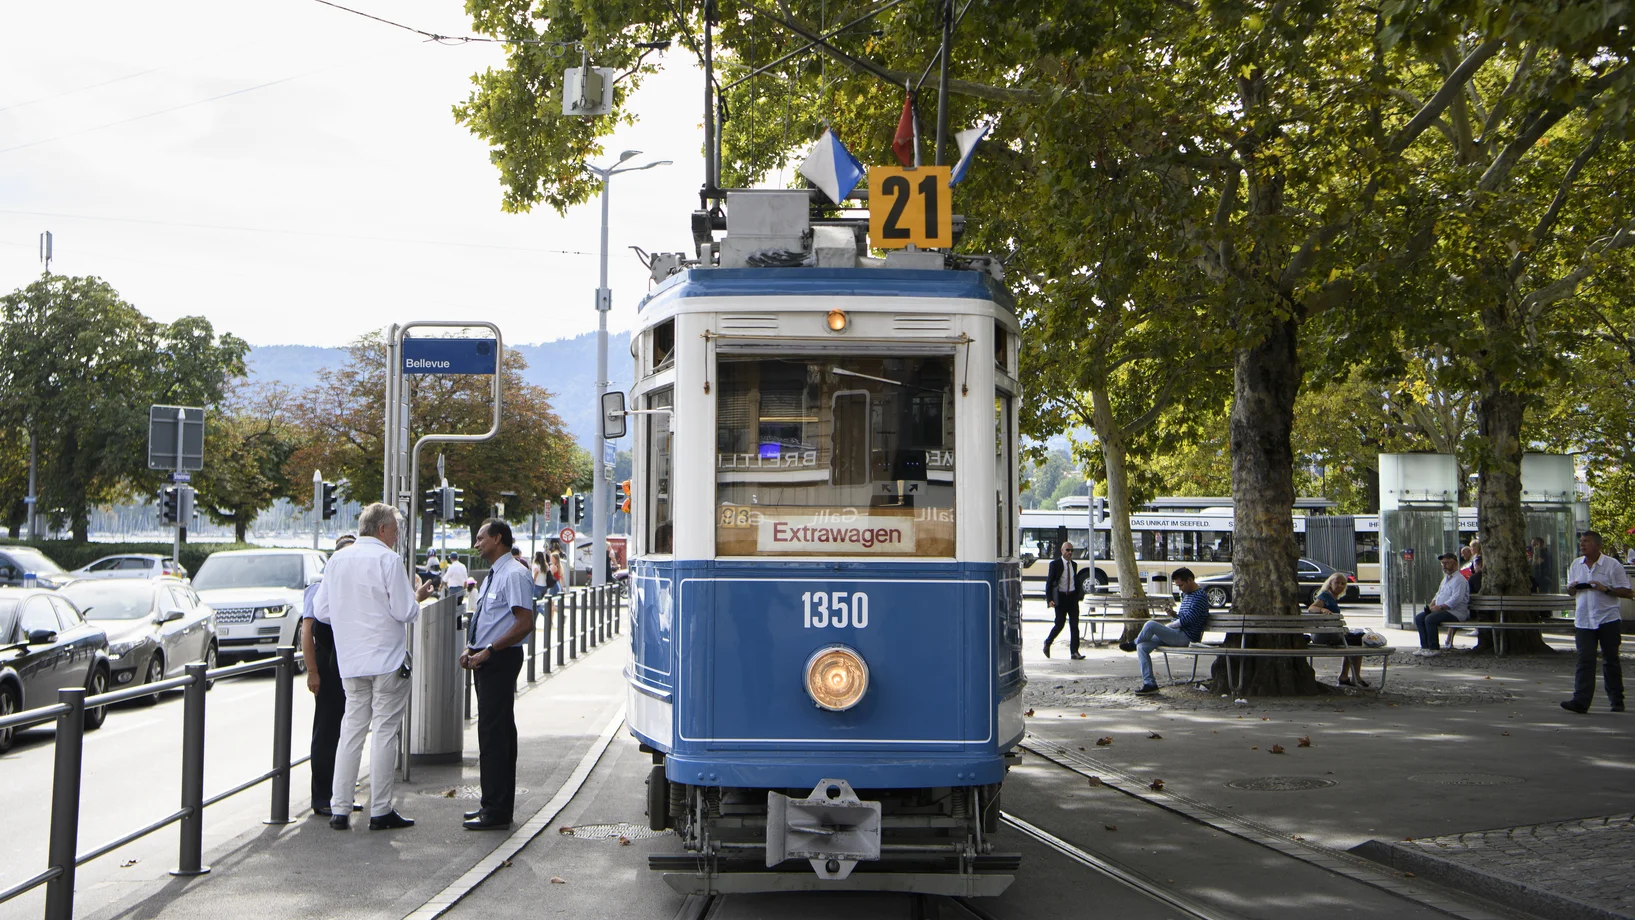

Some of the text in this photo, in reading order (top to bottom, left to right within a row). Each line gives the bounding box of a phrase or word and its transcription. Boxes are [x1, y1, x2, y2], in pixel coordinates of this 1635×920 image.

[882, 175, 938, 239] 21
[406, 358, 450, 368] Bellevue
[773, 521, 902, 549] Extrawagen
[801, 591, 869, 629] 1350
